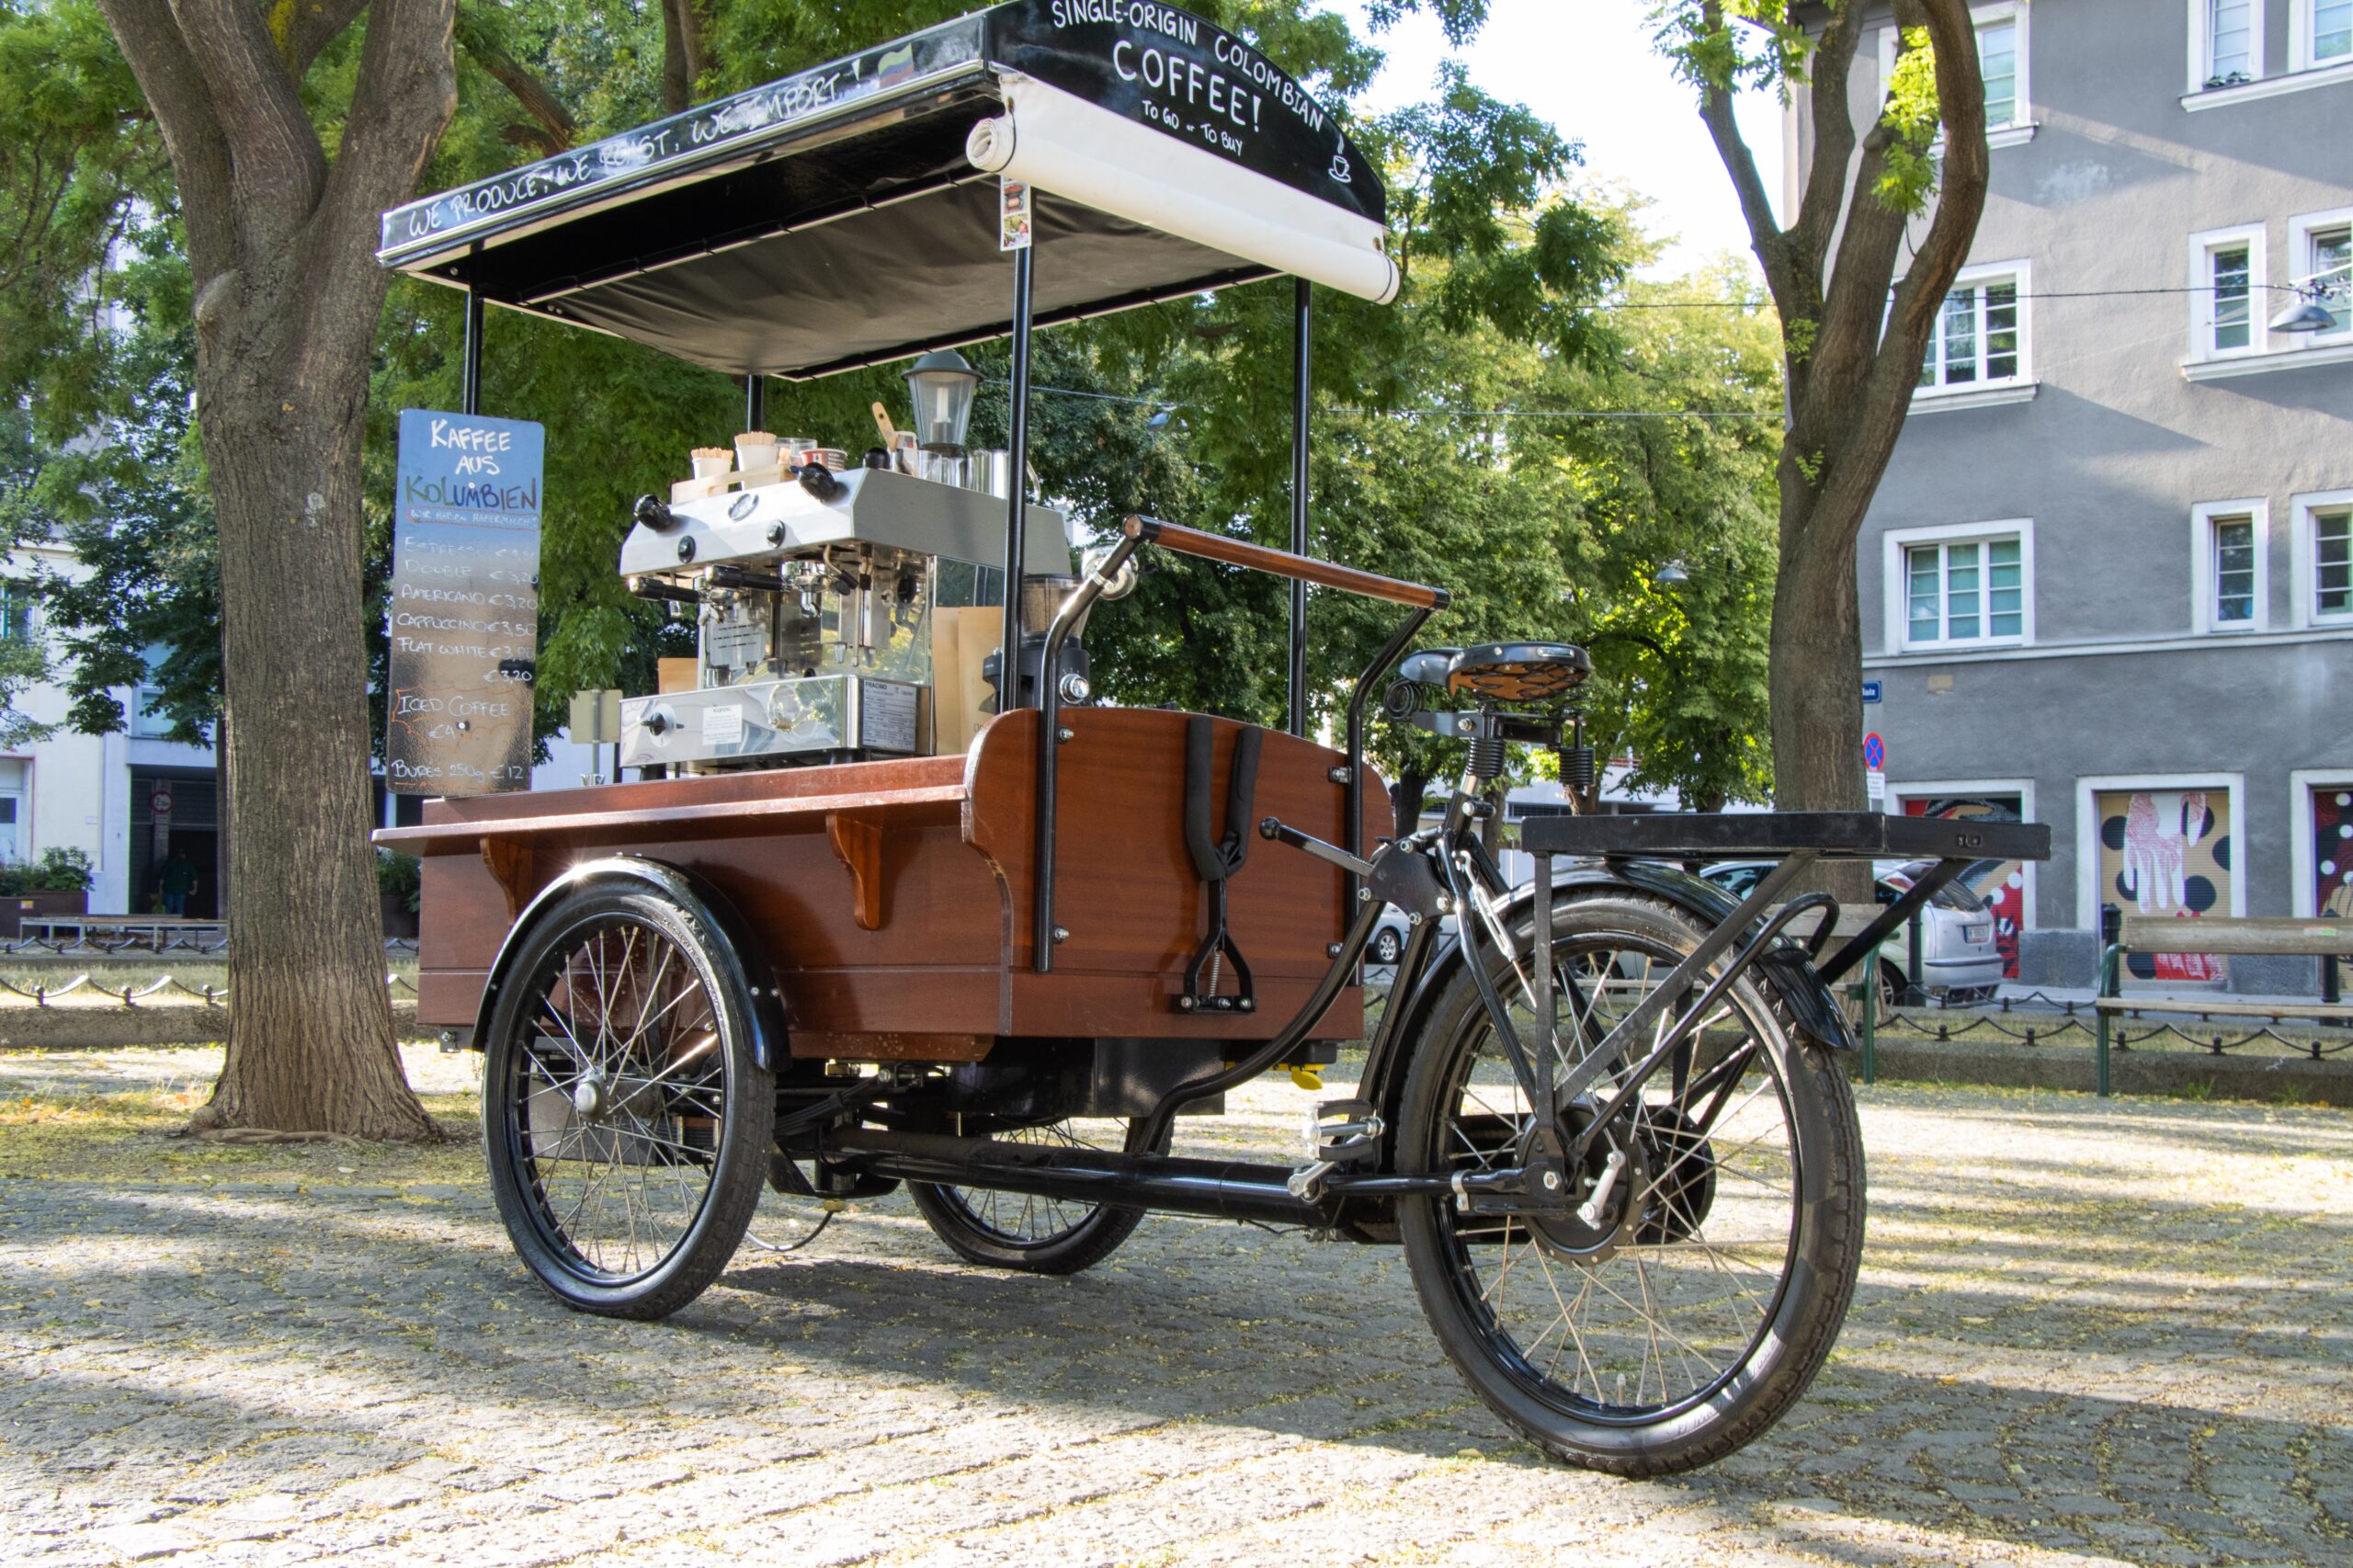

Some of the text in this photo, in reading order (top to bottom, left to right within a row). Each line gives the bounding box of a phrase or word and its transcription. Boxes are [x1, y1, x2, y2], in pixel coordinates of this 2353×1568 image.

[1051, 0, 1324, 133] SINGLE-ORIGIN COLOMBIAN
[1113, 40, 1262, 133] COFFEE!
[1142, 100, 1158, 119] TO
[1163, 107, 1179, 130] GO
[1200, 123, 1217, 143] TO
[1221, 131, 1243, 157] BUY
[409, 201, 441, 237] WE
[558, 154, 592, 187] WE
[692, 106, 733, 142] WE
[430, 418, 511, 452] KAFFEE
[455, 455, 501, 475] AUS
[405, 475, 537, 511] KOLUMBIEN
[404, 559, 472, 578] DOUBLE
[402, 584, 485, 605] AMERICANO
[397, 613, 486, 632] CAPPUCCINO
[397, 637, 435, 653] FLAT
[438, 646, 486, 658] WHITE
[865, 682, 888, 690] FRACINO
[397, 696, 510, 717] ICED COFFEE
